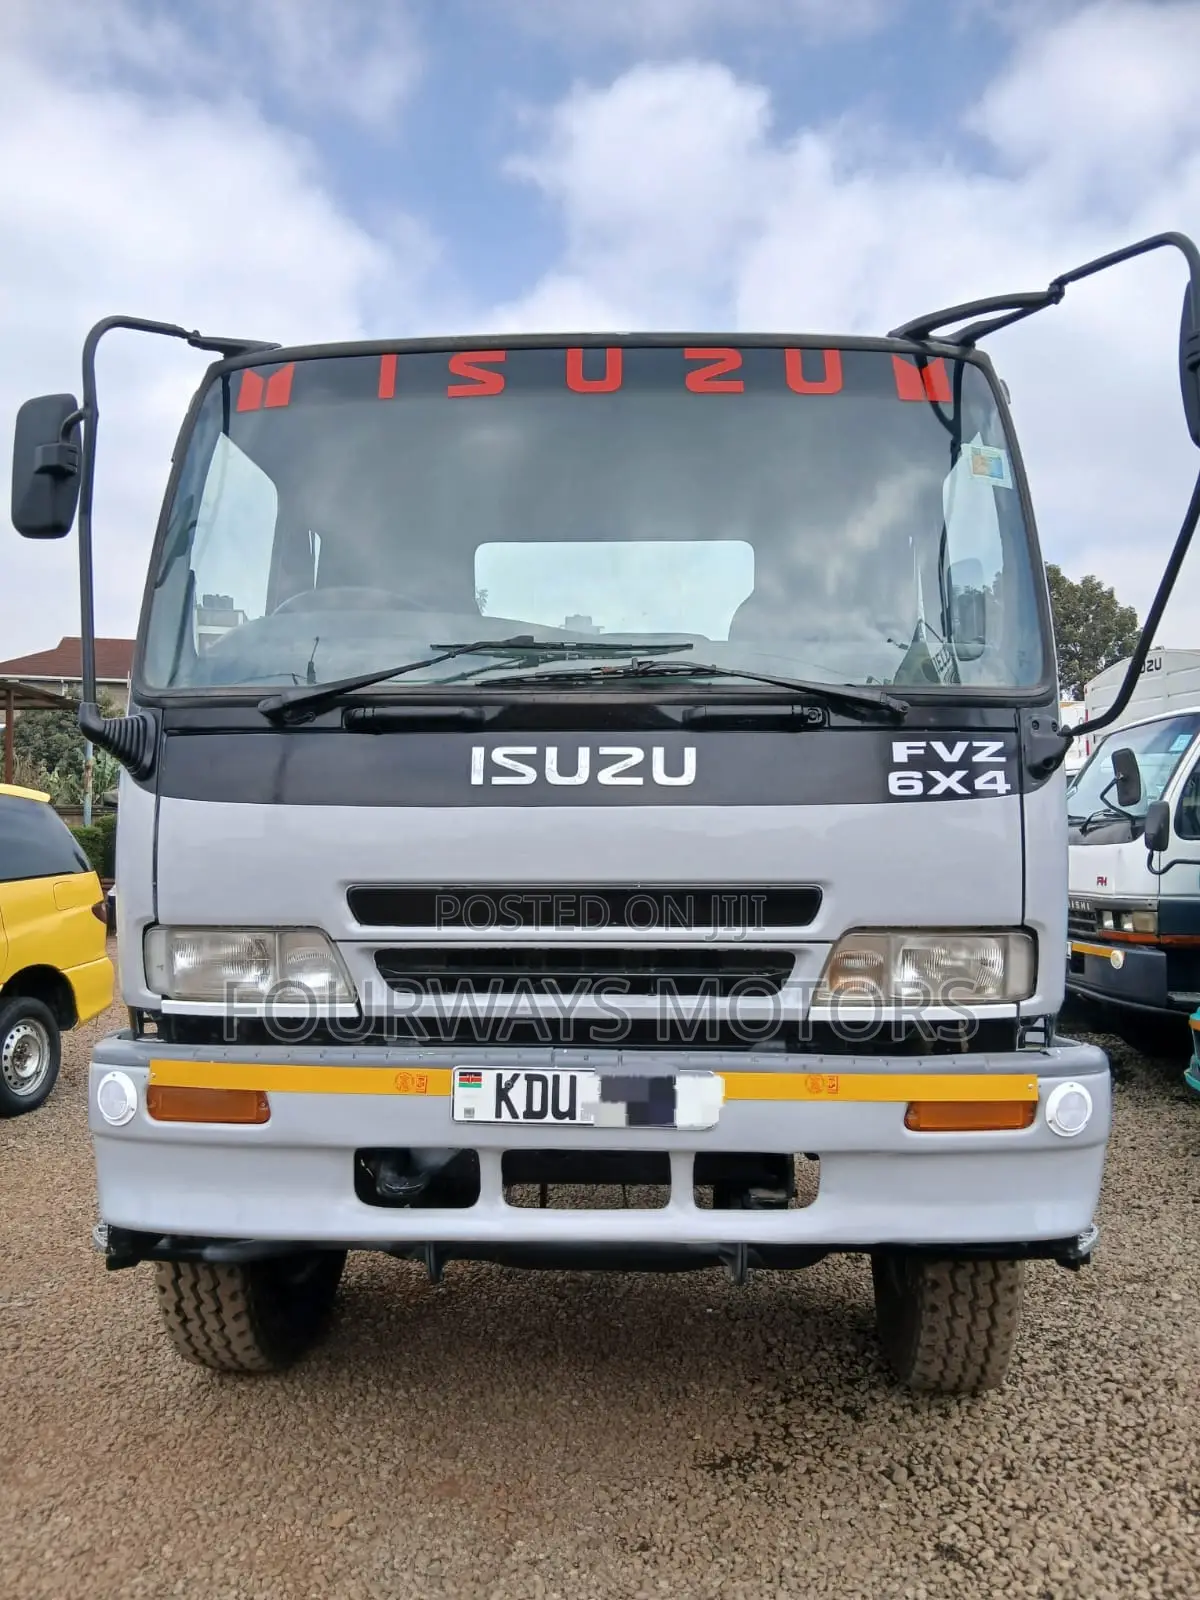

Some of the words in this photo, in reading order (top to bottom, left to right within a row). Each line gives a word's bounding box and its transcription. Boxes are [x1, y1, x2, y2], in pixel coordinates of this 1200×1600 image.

[378, 347, 843, 399] ISUZU
[471, 746, 697, 786] ISUZU
[891, 741, 1007, 763] FVZ
[887, 770, 1012, 796] 6X4
[494, 1072, 577, 1121] KDU
